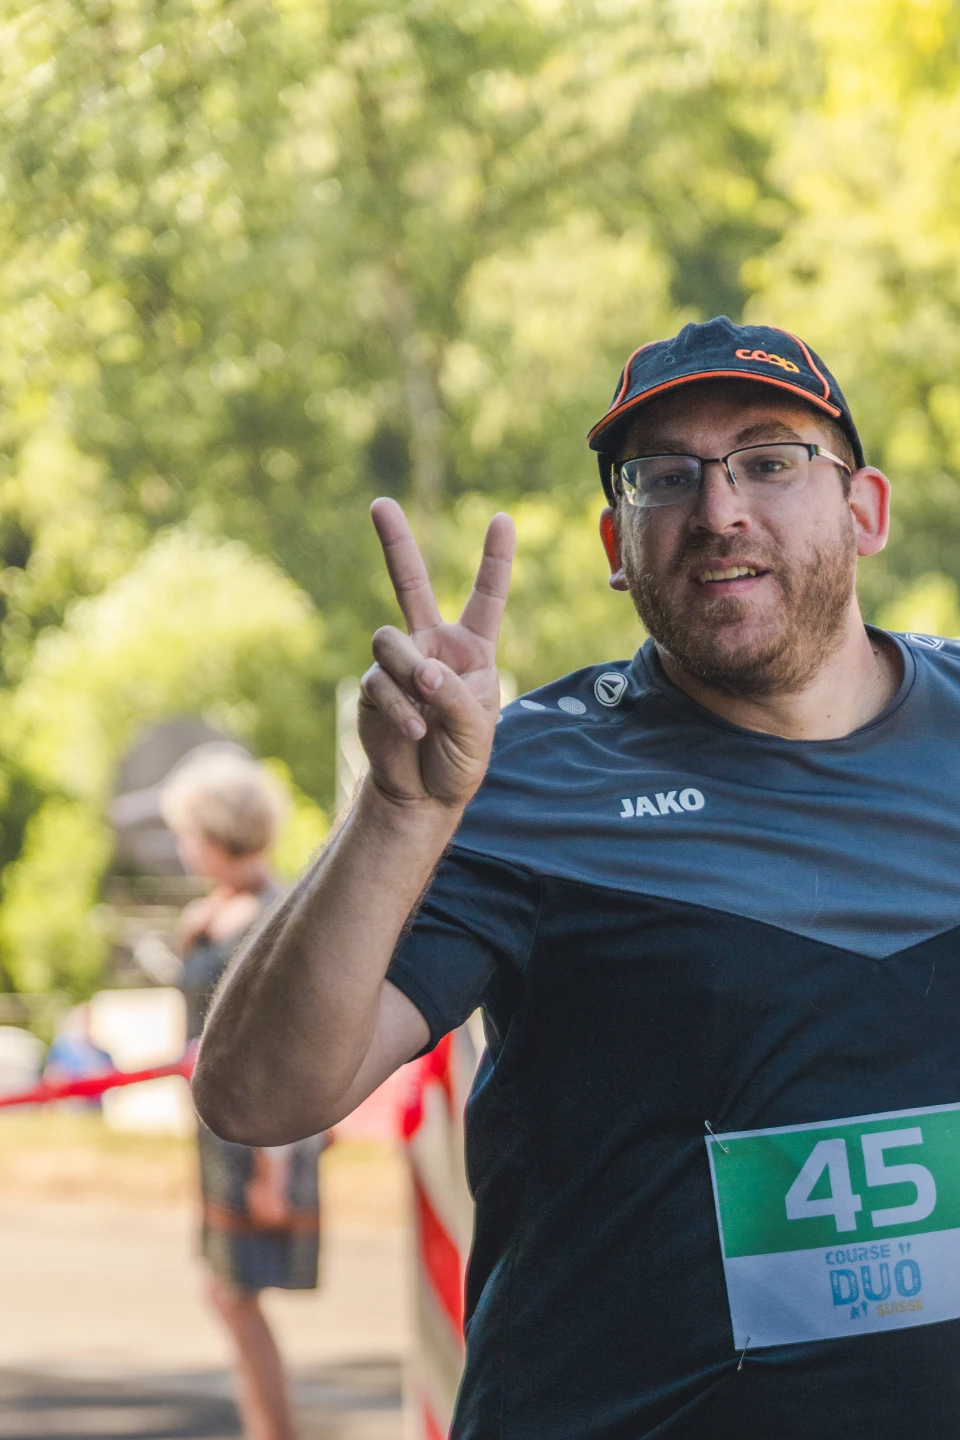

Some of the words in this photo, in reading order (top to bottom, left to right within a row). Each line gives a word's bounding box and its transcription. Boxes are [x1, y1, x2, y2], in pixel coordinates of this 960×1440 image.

[619, 787, 705, 818] JAKO
[784, 1126, 937, 1233] 45
[825, 1243, 891, 1265] COURSE
[829, 1258, 922, 1307] DUO
[876, 1298, 925, 1317] SUISSE
